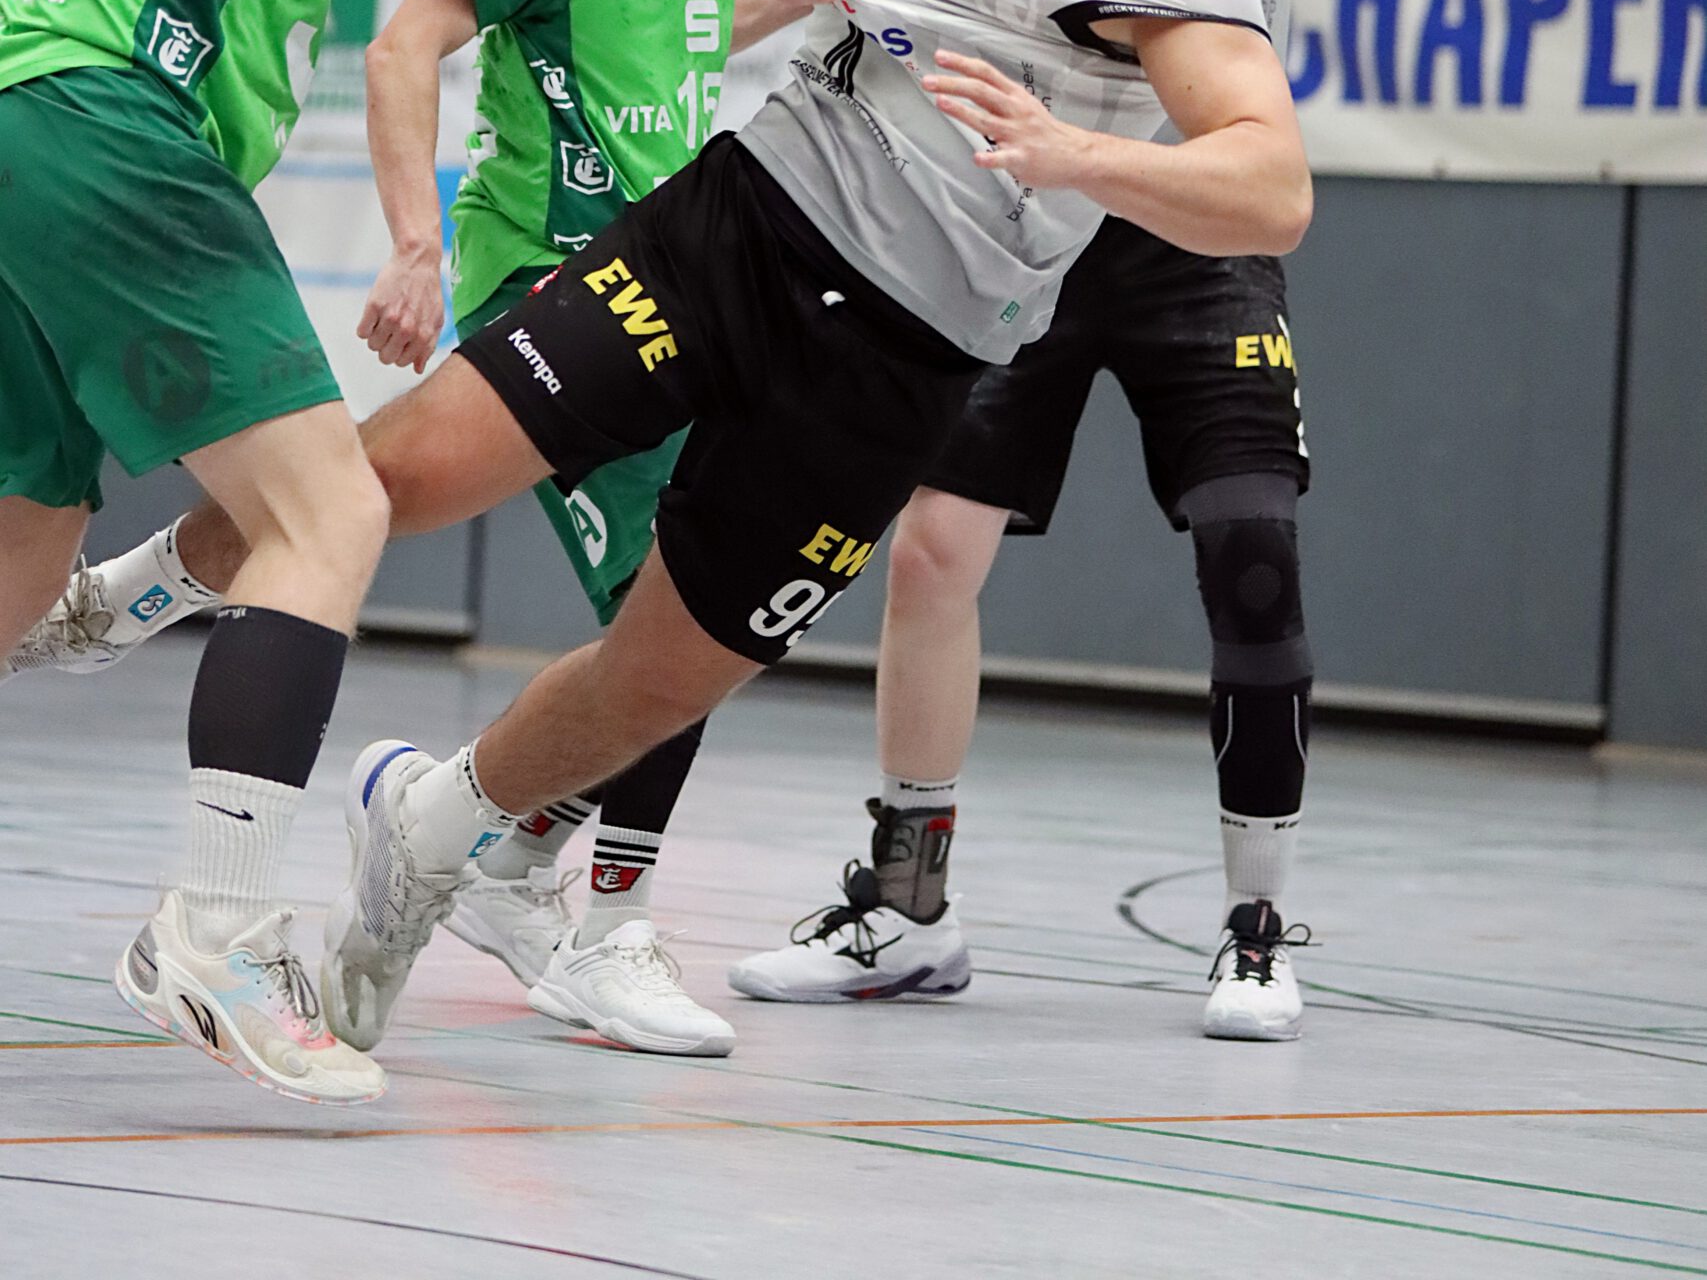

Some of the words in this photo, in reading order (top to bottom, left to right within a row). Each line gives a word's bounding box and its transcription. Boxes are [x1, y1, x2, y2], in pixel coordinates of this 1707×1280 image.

[604, 105, 674, 134] VITA
[582, 257, 679, 373] EWE
[507, 327, 563, 395] Kempa
[1235, 333, 1297, 377] EW
[799, 523, 878, 577] EW
